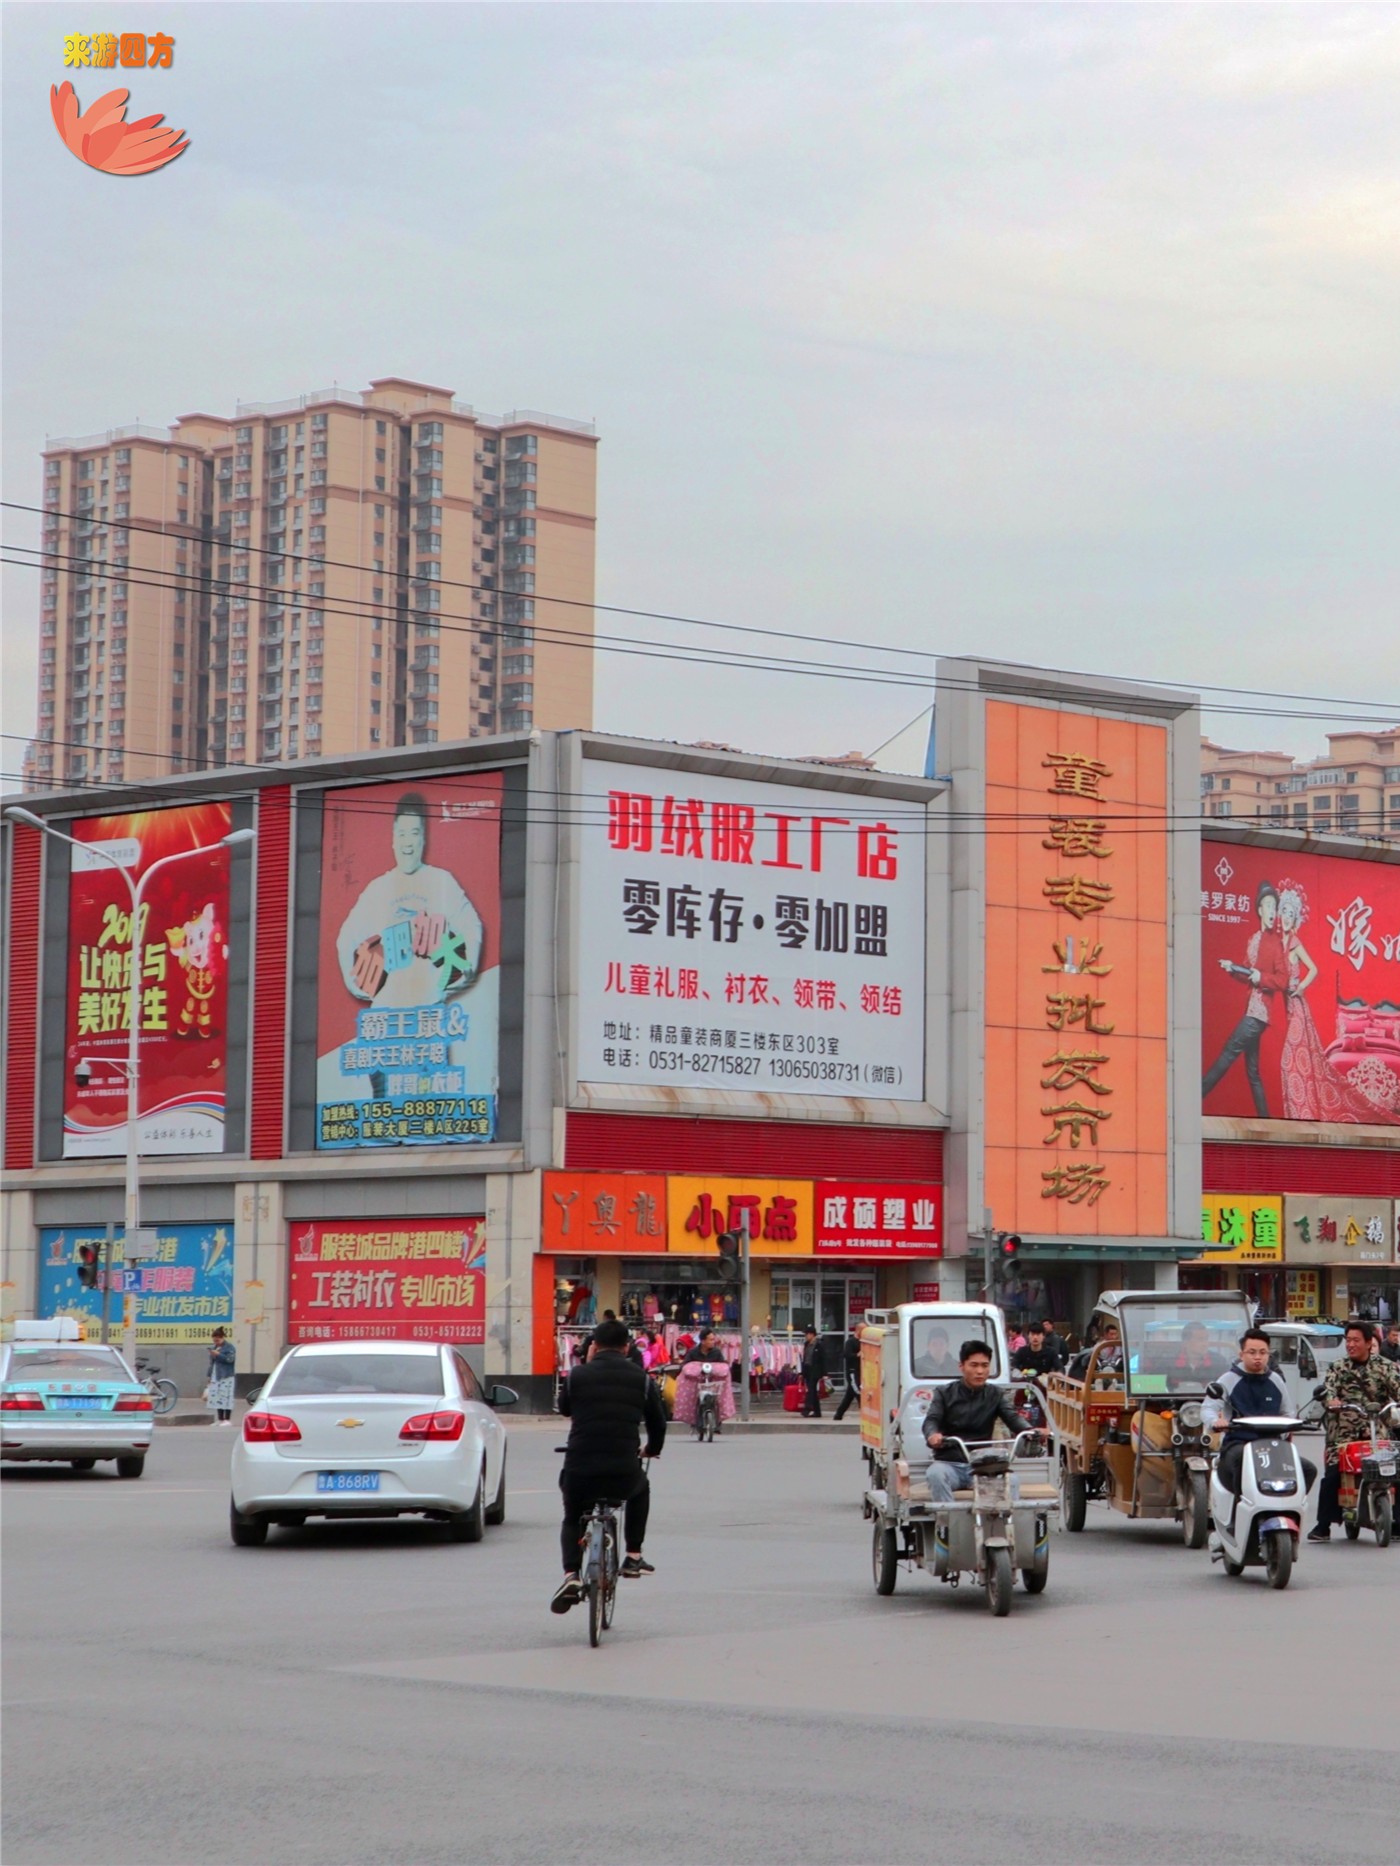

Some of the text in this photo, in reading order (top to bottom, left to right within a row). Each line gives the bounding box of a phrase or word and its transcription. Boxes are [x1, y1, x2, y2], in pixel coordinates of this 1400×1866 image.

[608, 790, 898, 880] 羽绒服工厂店
[623, 878, 888, 956] 零库存·零加盟
[78, 986, 167, 1035] 美好发生
[686, 1193, 798, 1241] 小雨点
[823, 1196, 935, 1231] 成硕塑业
[320, 1231, 464, 1261] 服装城品牌港四楼
[124, 1271, 135, 1290] P
[308, 1269, 476, 1309] 工装衬衣 专业市场
